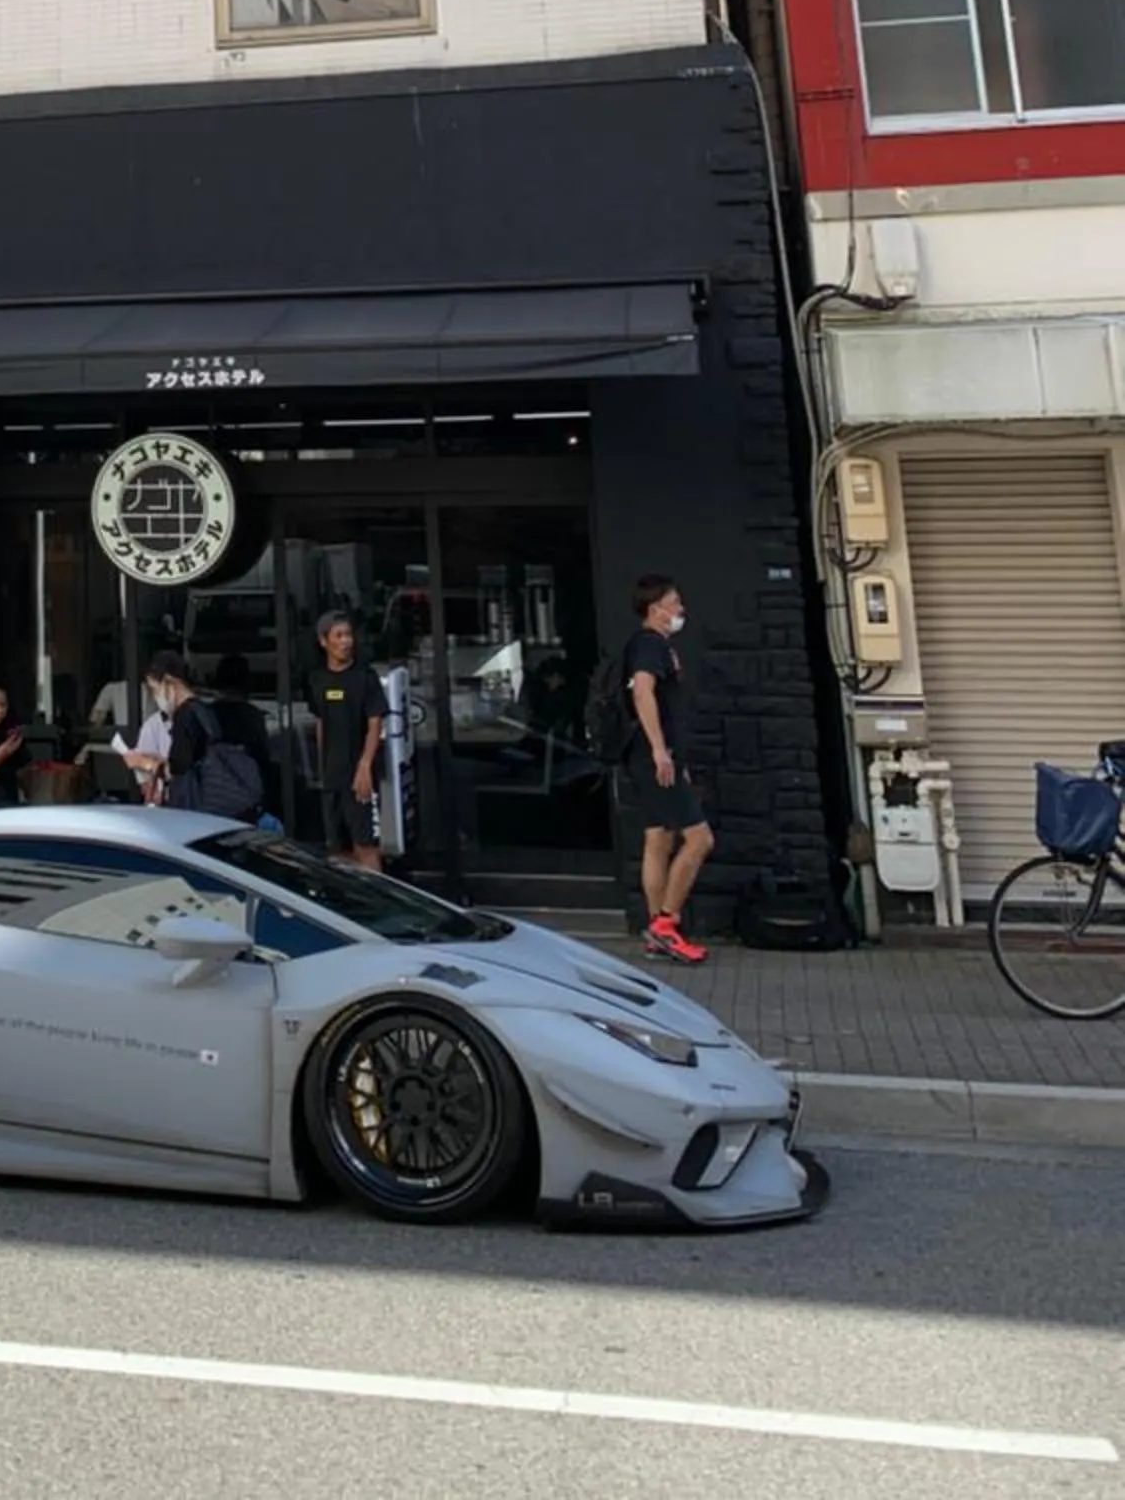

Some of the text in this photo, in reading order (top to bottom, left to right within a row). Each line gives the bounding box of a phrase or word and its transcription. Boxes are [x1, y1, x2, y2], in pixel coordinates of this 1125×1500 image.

[146, 369, 265, 388] アクセスホテル
[101, 519, 224, 577] アクセスホテル
